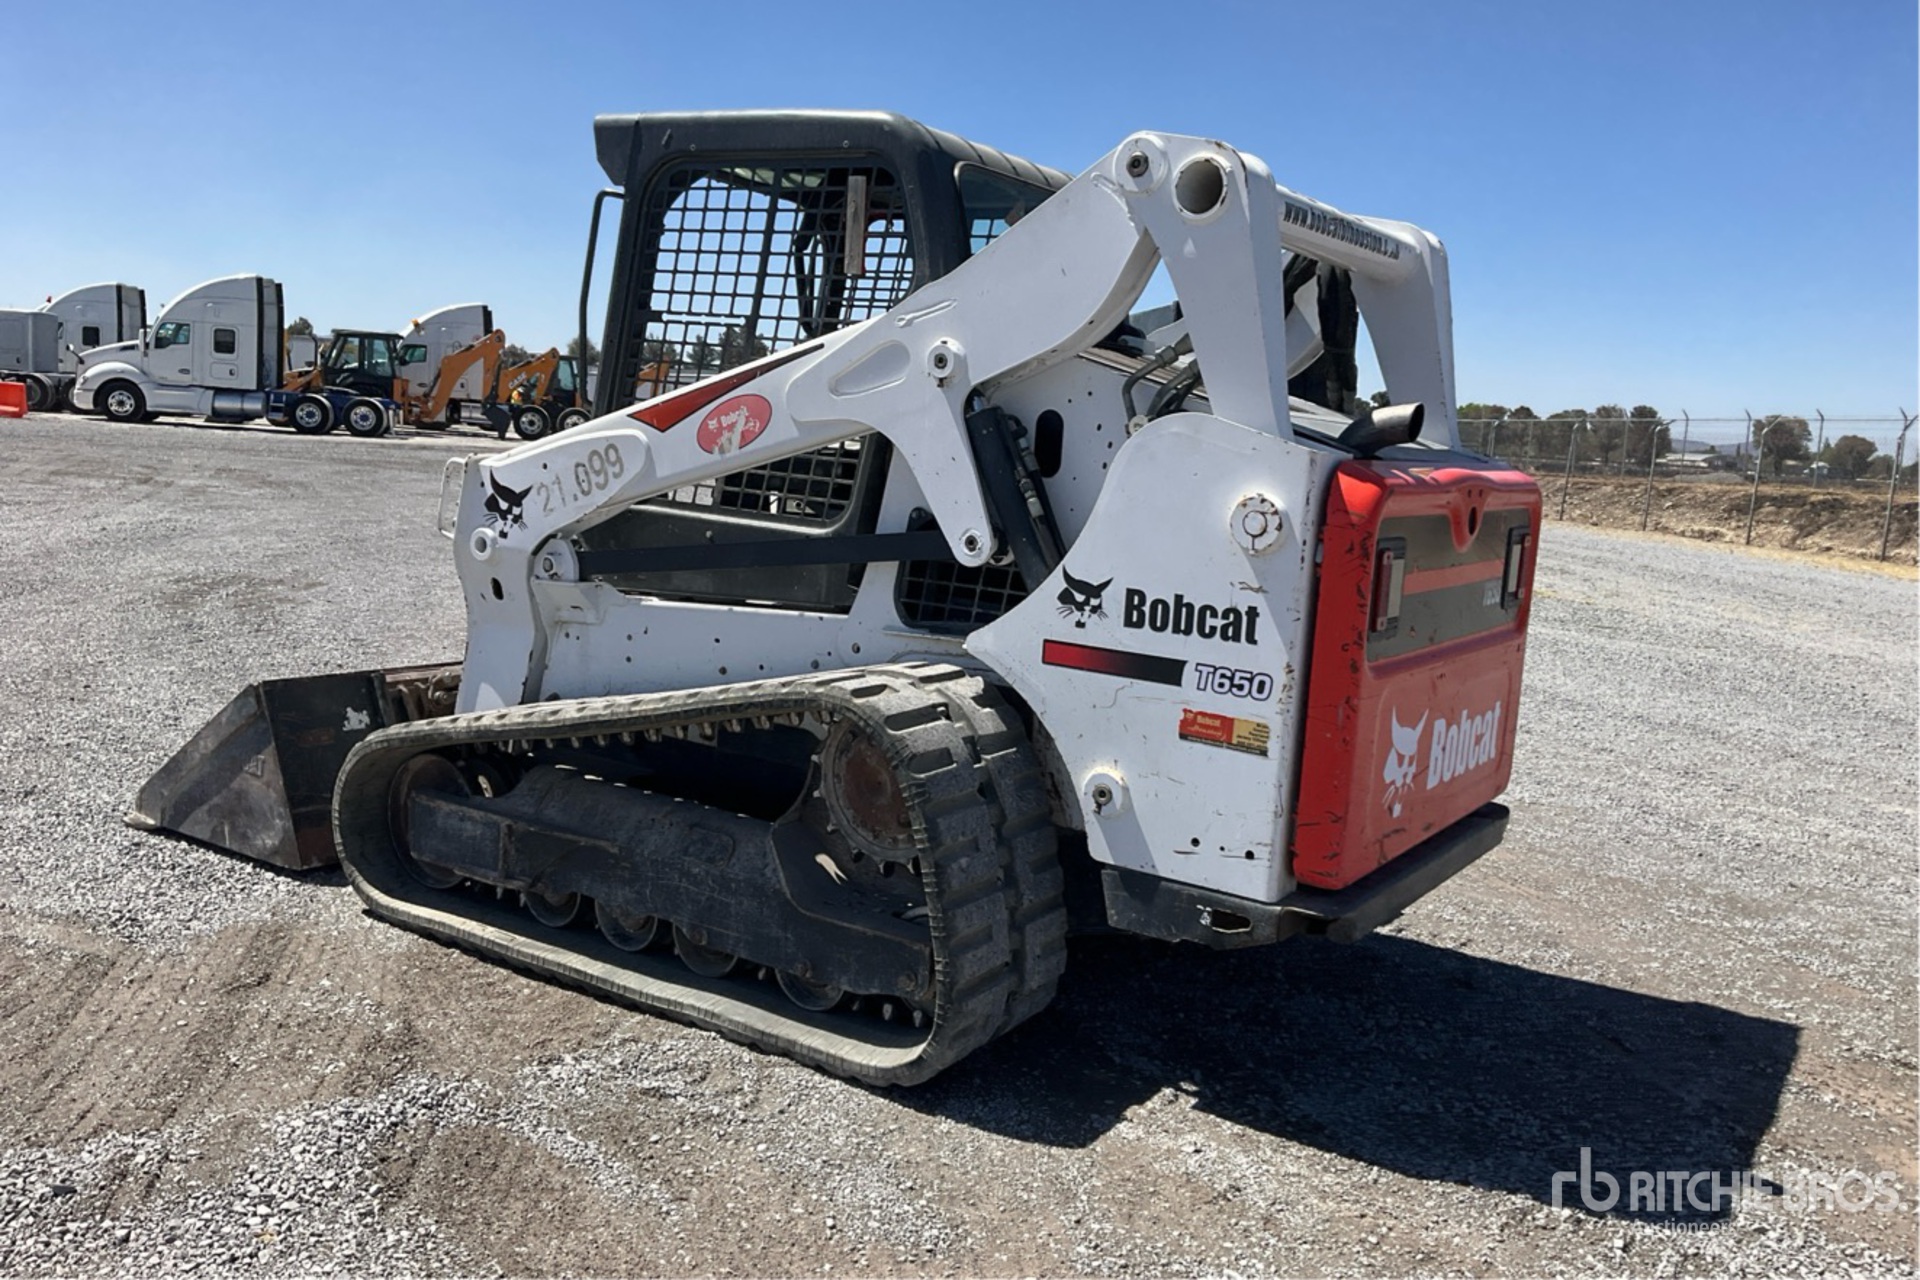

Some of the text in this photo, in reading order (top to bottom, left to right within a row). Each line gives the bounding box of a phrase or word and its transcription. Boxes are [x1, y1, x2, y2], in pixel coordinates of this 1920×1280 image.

[537, 443, 624, 517] 21.099
[1123, 587, 1260, 646] Bobcat
[1195, 662, 1274, 701] T650
[1426, 700, 1501, 790] Bobcat
